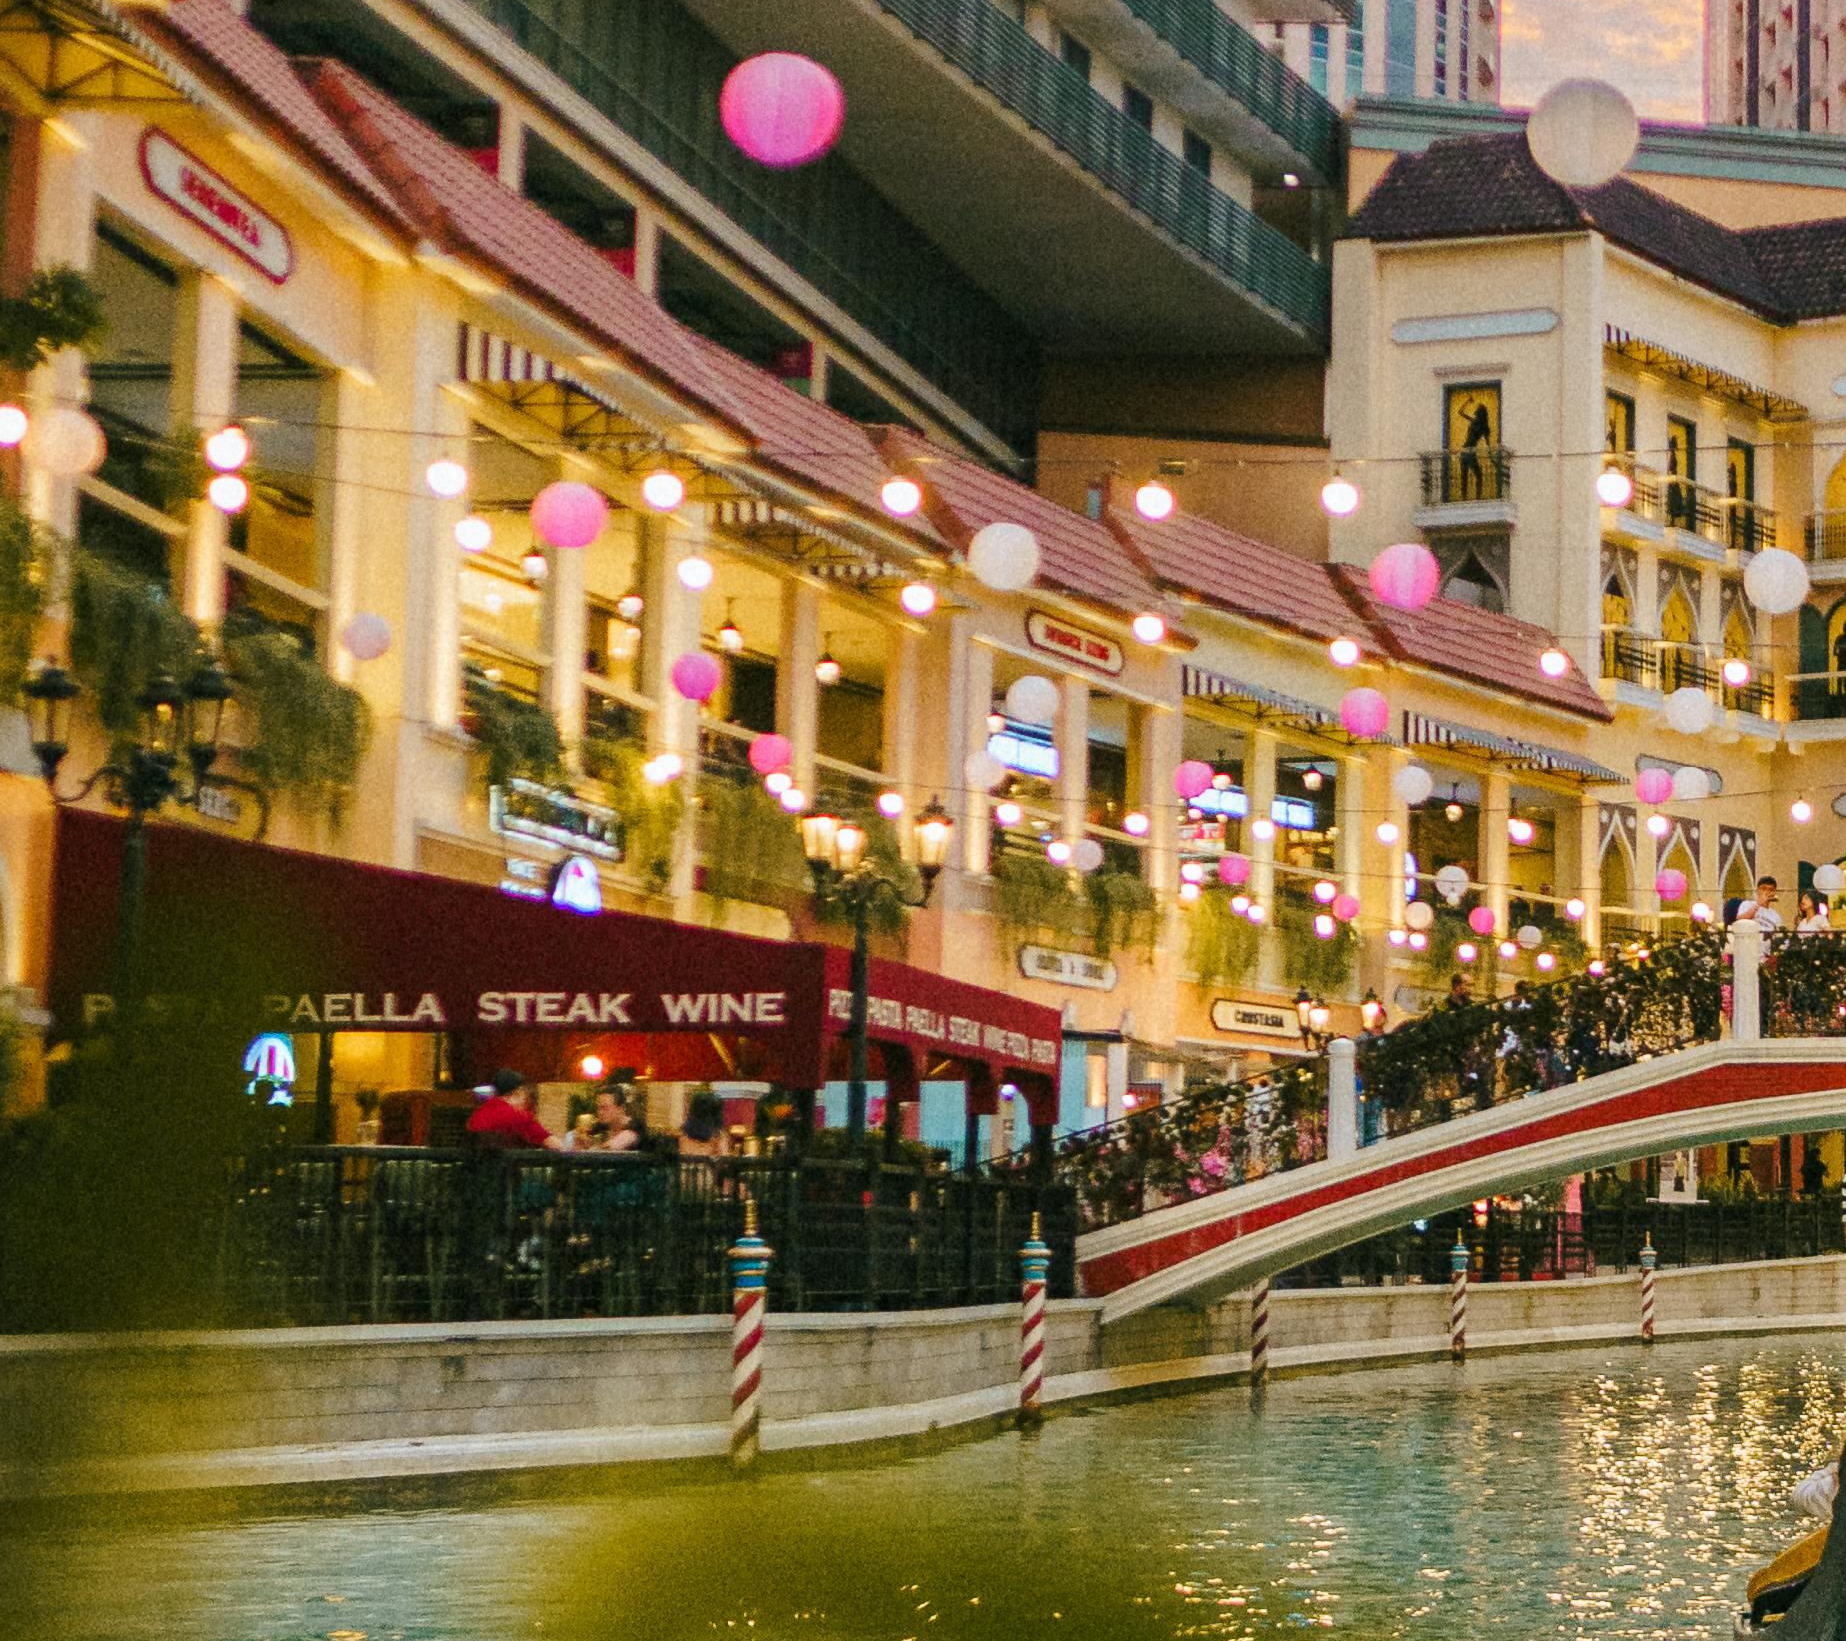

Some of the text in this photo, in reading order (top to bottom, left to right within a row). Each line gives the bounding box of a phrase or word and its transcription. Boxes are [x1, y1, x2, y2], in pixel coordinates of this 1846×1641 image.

[262, 992, 447, 1024] PAELLA
[477, 991, 632, 1024] STEAK
[660, 991, 786, 1024] WINE
